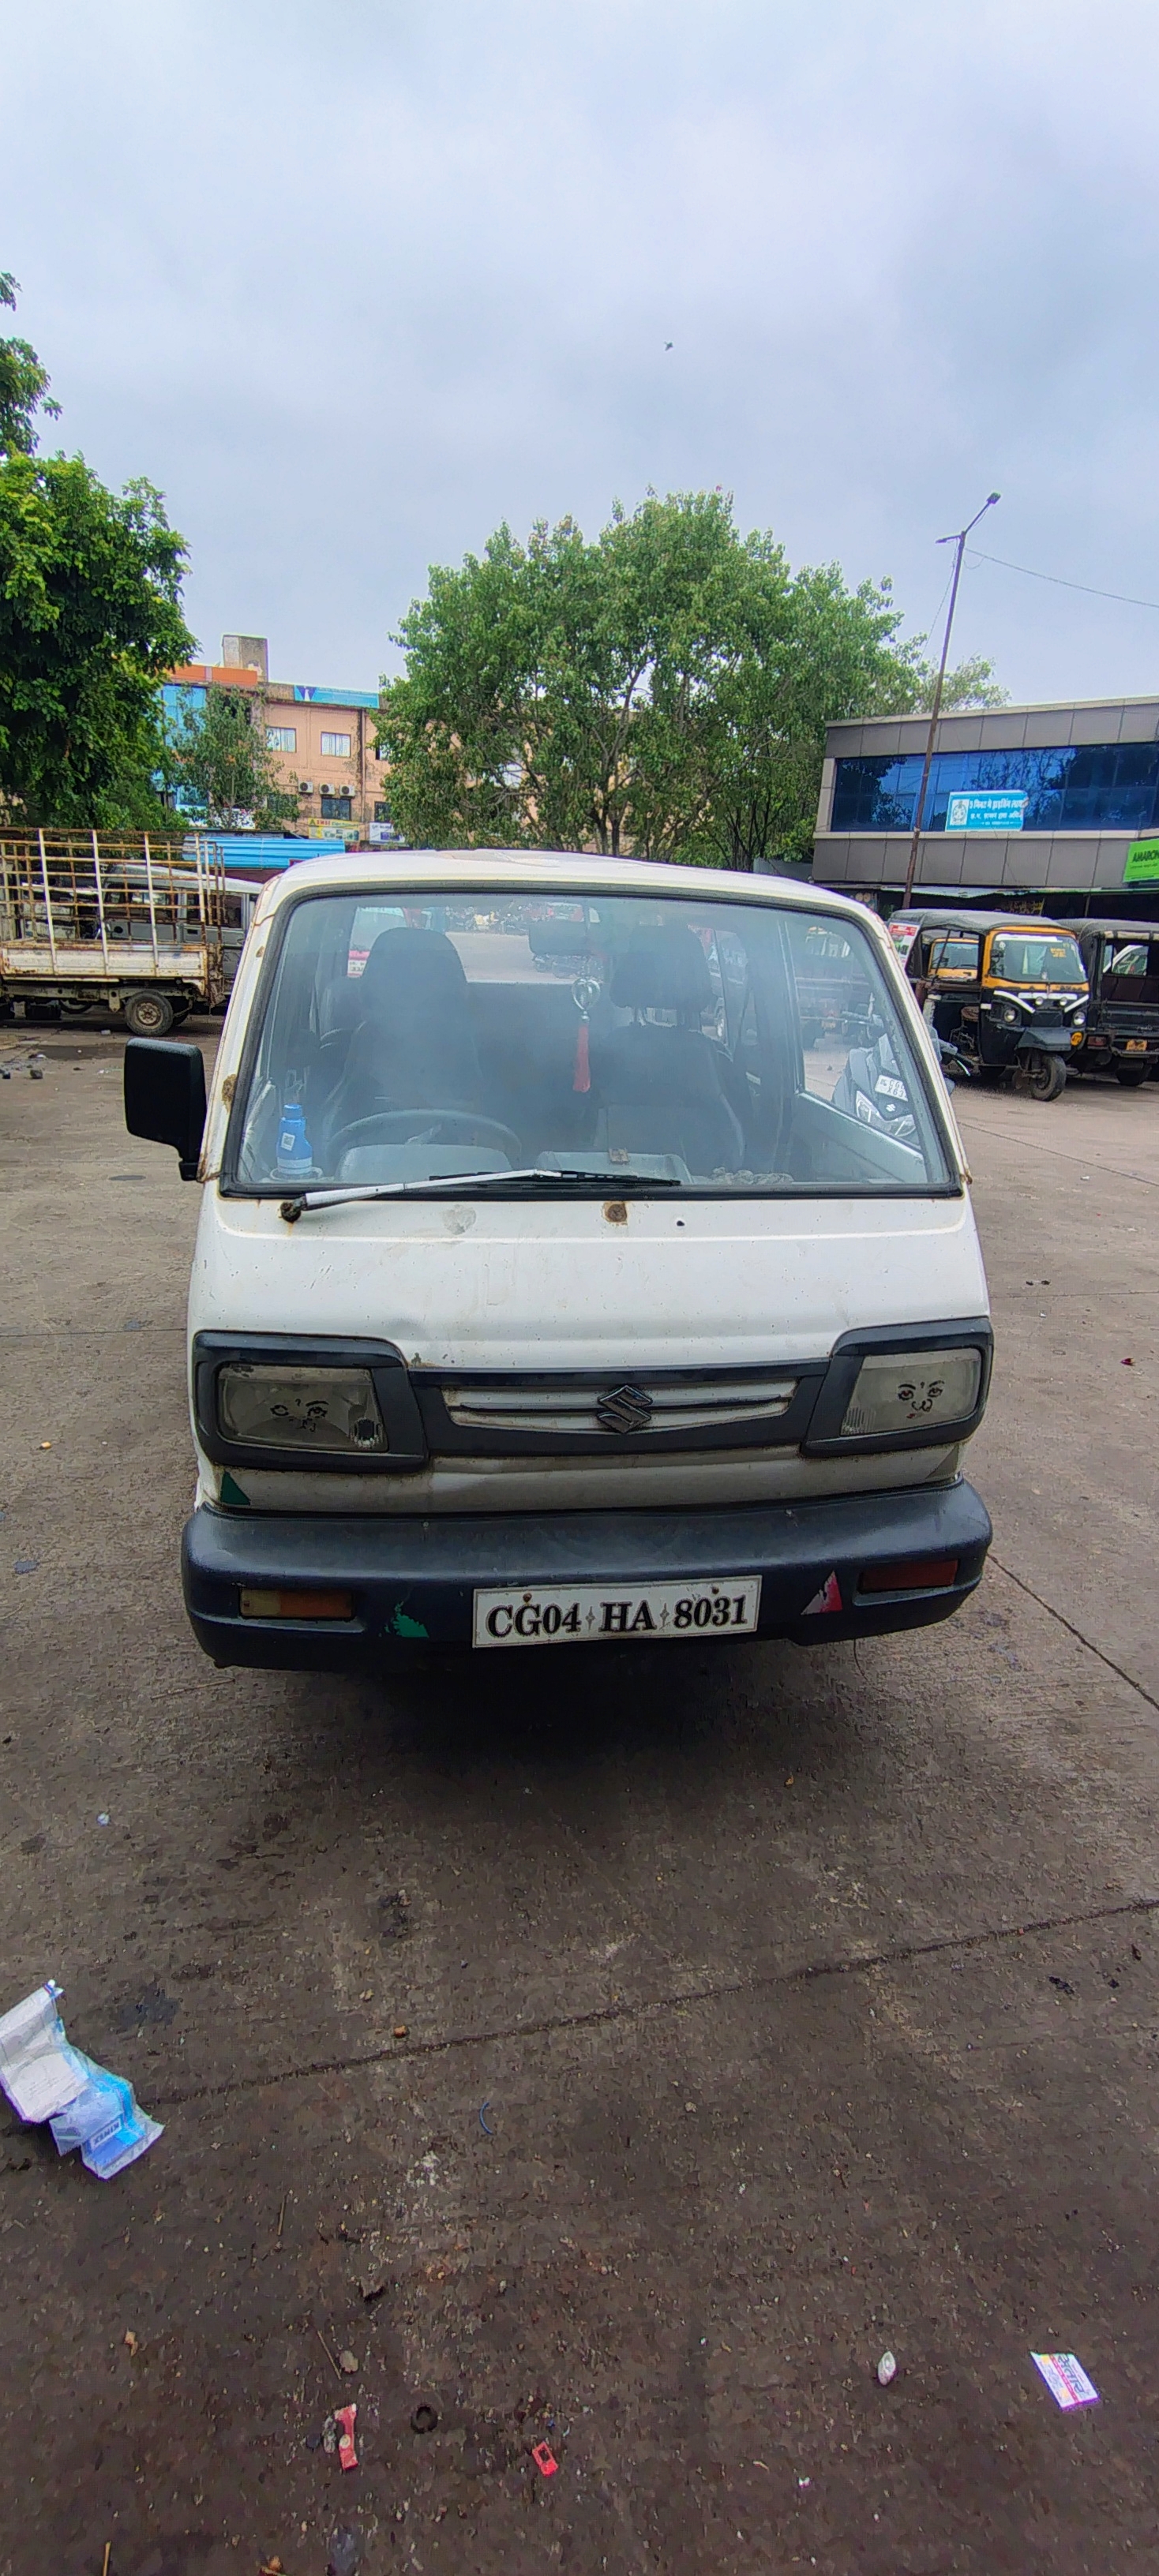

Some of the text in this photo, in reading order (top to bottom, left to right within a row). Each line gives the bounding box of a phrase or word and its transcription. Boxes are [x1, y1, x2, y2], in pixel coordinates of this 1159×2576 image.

[486, 1594, 748, 1638] CG04 HA 8031
